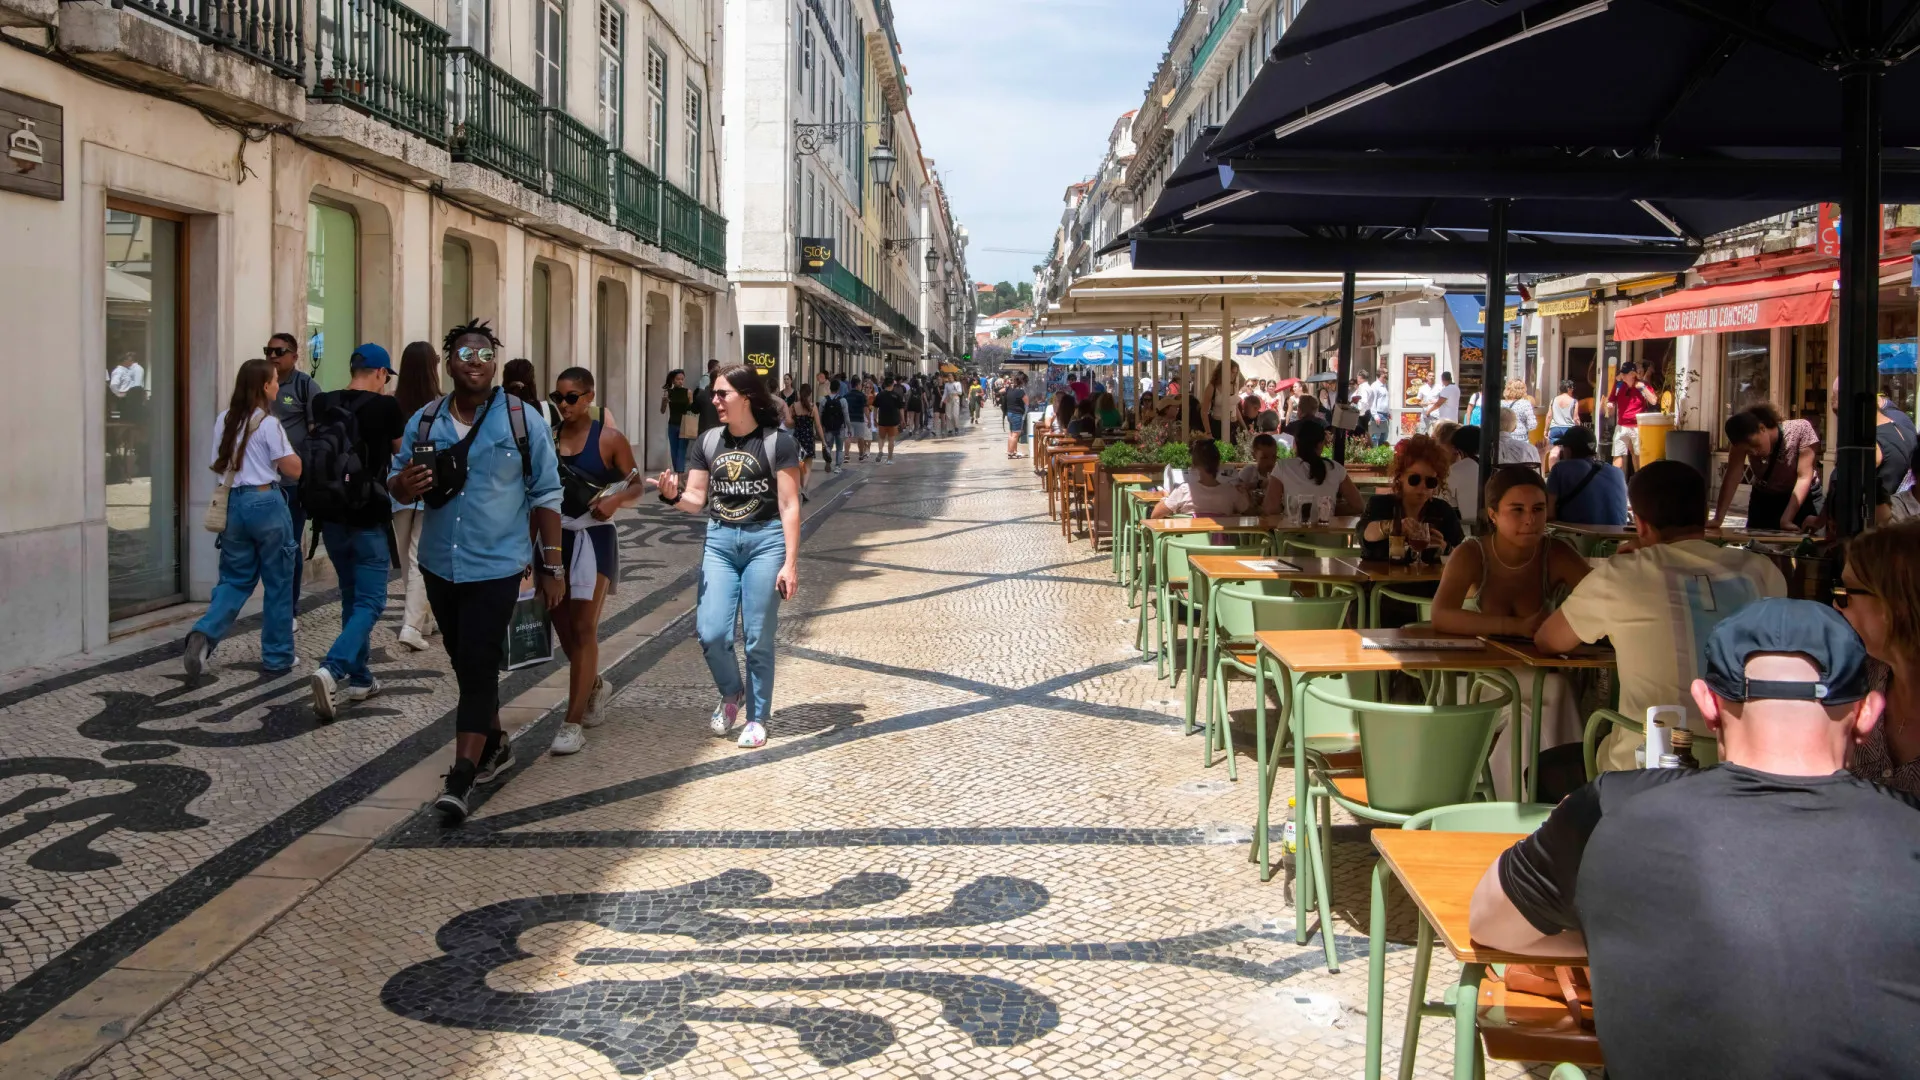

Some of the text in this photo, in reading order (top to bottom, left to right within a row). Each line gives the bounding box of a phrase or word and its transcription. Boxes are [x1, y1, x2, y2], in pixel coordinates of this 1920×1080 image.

[1664, 303, 1758, 332] CASA PEREIRA DA CONCEIÇÃO
[716, 454, 754, 466] BREWED IN
